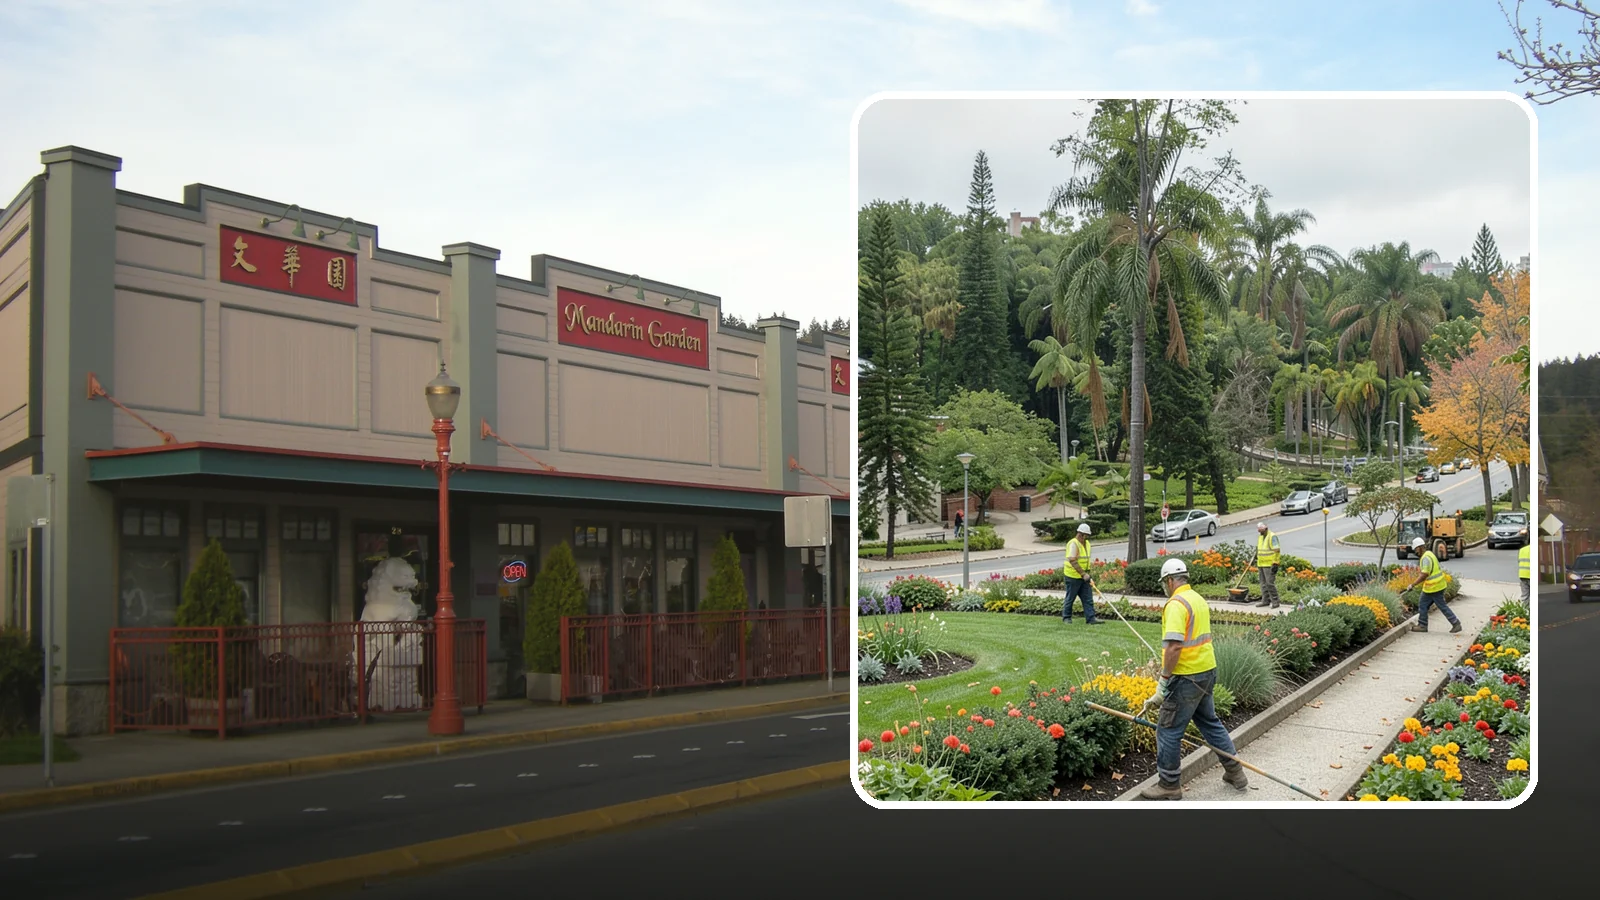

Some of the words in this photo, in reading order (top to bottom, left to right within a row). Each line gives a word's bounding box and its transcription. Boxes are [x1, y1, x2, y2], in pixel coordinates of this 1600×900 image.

[231, 236, 346, 290] 文華園
[564, 302, 644, 340] Mandarin
[648, 320, 701, 352] Garden
[503, 565, 527, 578] OPEN
